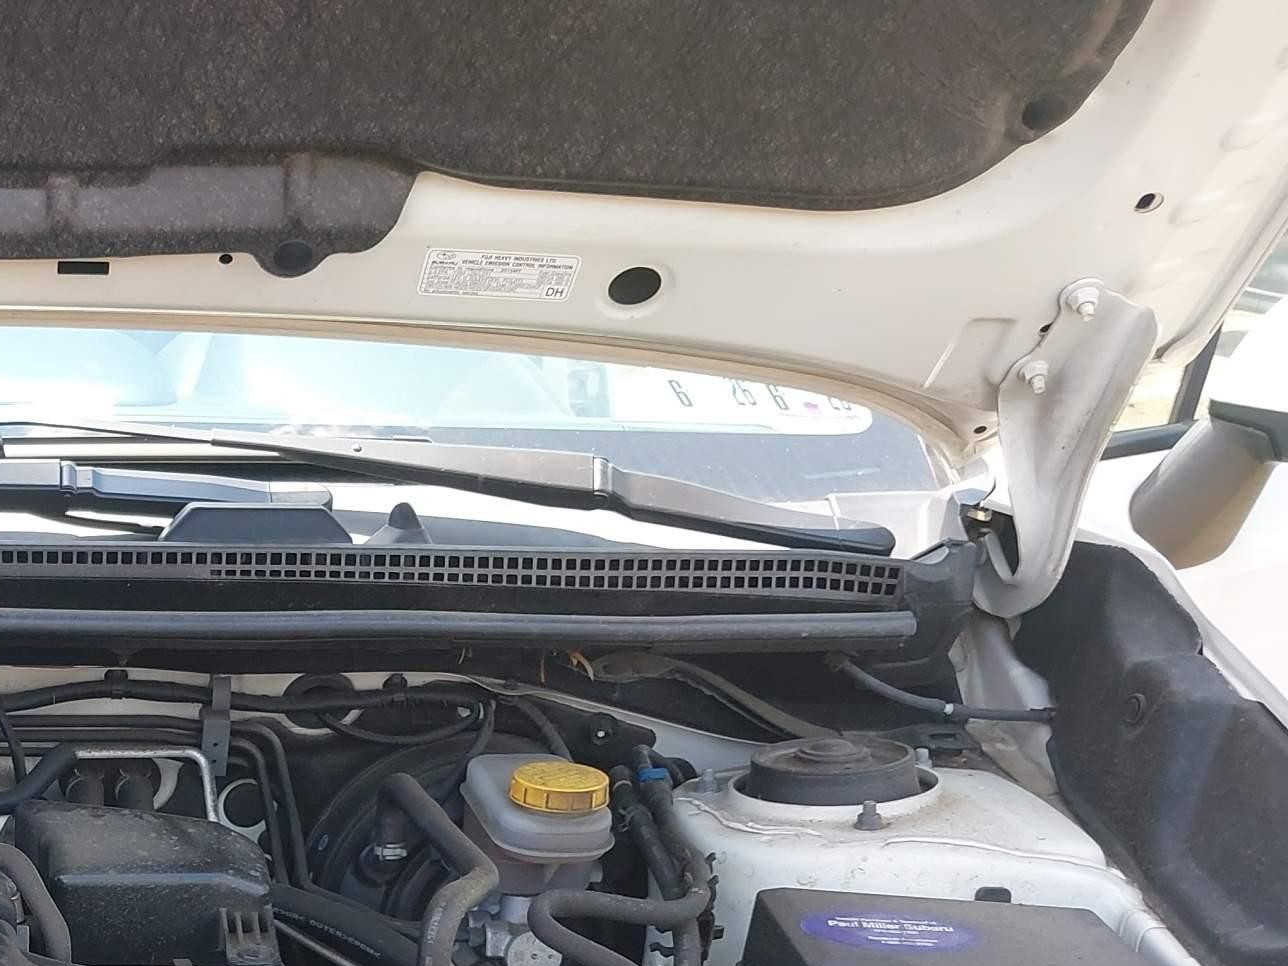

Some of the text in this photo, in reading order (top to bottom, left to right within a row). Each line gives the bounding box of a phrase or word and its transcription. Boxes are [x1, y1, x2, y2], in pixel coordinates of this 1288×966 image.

[545, 287, 564, 297] DH
[827, 919, 859, 928] Paul
[862, 920, 900, 930] Miller
[903, 923, 954, 932] Subaru
